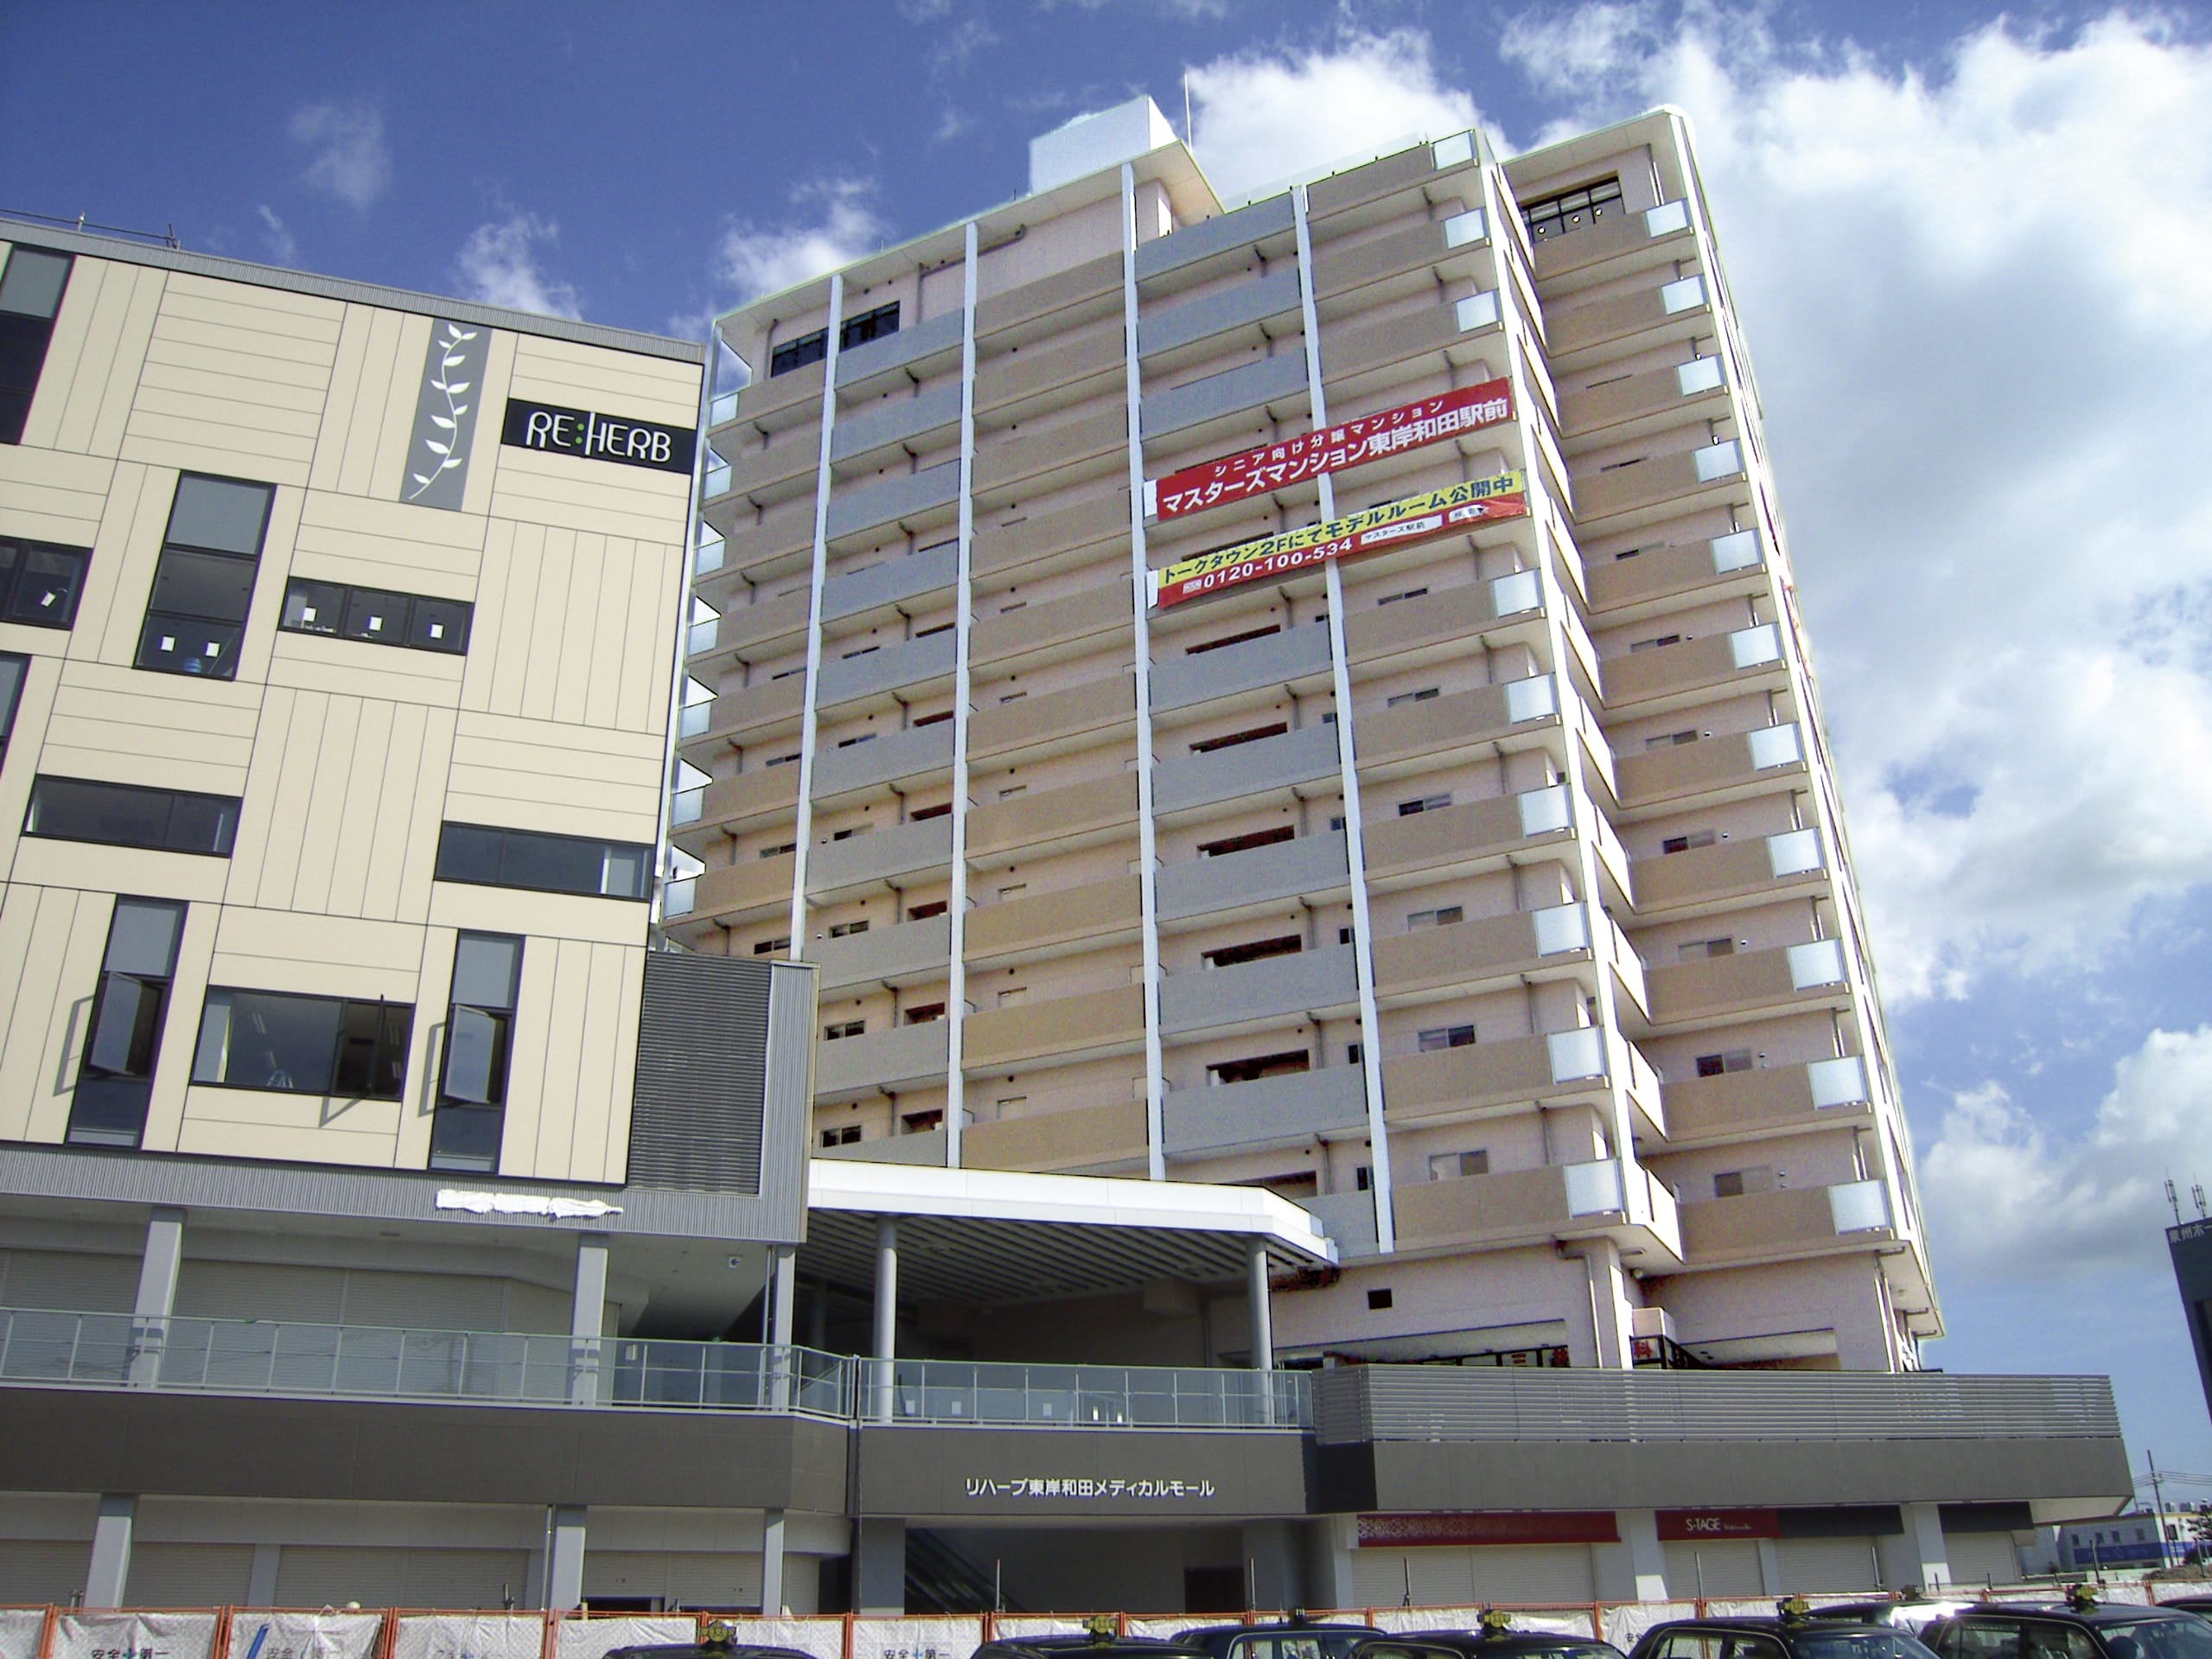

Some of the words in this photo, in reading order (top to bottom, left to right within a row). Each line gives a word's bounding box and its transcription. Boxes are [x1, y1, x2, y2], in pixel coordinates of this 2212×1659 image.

[1163, 397, 1508, 513] マスターズマンション東岸和田駅前
[1203, 538, 1353, 589] 0120-100-534
